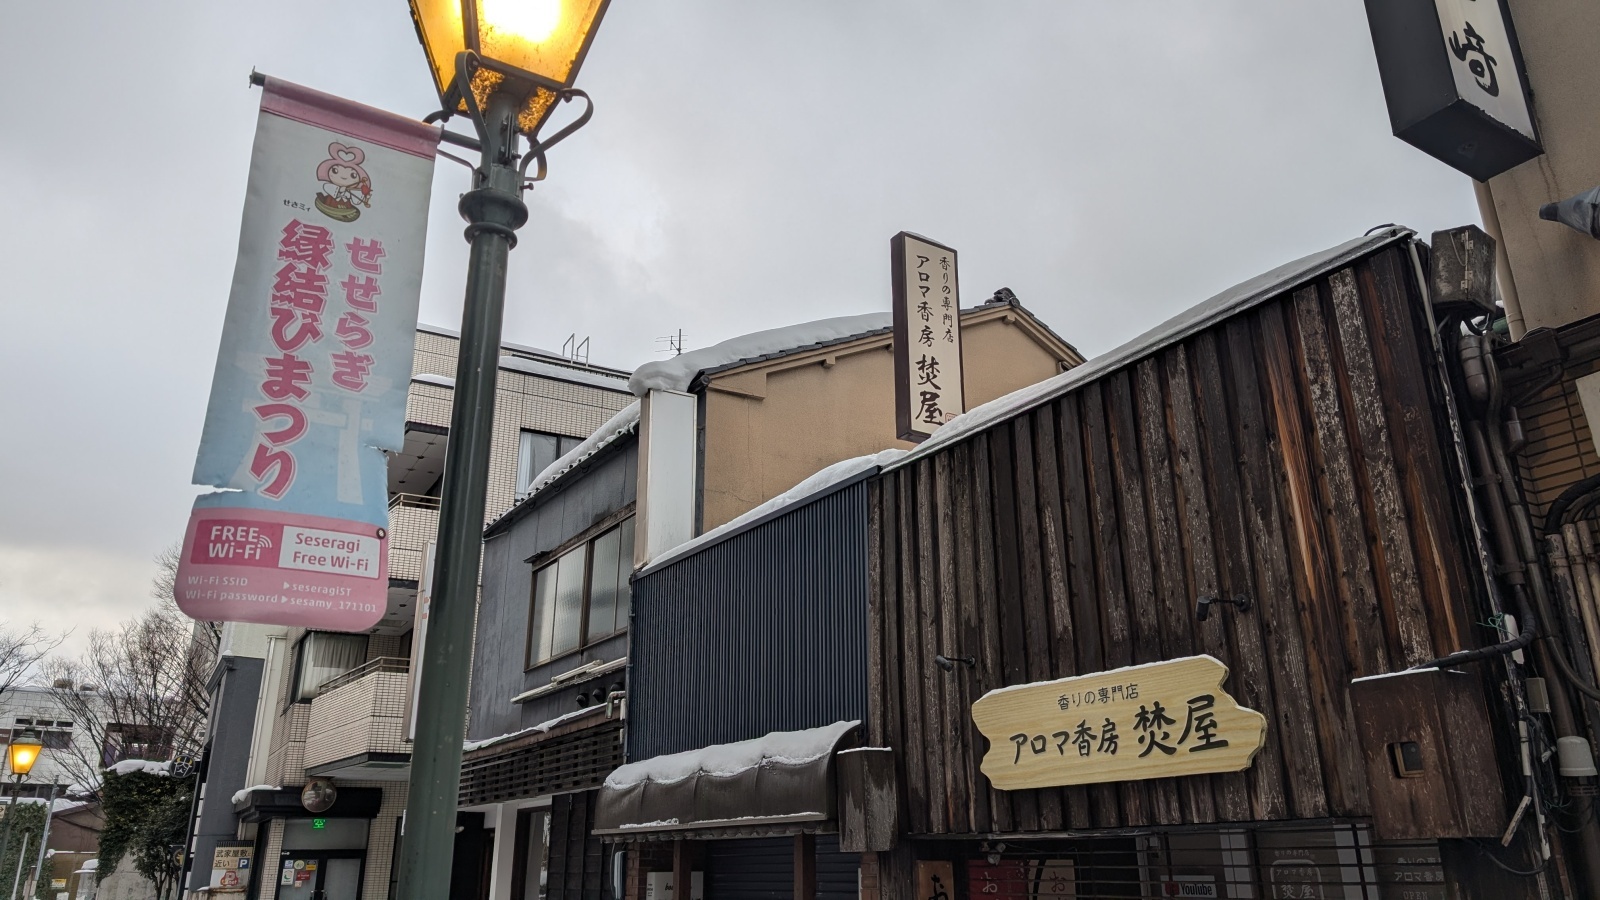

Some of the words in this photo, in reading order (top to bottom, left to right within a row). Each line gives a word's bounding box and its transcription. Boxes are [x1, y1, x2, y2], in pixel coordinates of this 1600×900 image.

[916, 254, 935, 348] アロマ香房
[939, 256, 954, 344] 香りの専門店
[329, 236, 386, 392] せせらぎ
[250, 219, 335, 500] 縁結びまつり
[915, 353, 944, 426] 焚屋
[210, 525, 259, 542] FREE
[295, 532, 360, 553] Seseragi
[208, 542, 261, 560] Wi-Fi
[293, 551, 326, 566] Free
[330, 555, 368, 571] Wi-Fi
[187, 575, 219, 585] Wi-Fi
[222, 576, 248, 586] SSID
[292, 583, 352, 596] seseragiST
[185, 590, 217, 599] Wi-Fi
[220, 590, 278, 603] password
[290, 597, 377, 612] sesamy_171101
[1057, 683, 1139, 711] 香りの専門店
[1009, 717, 1119, 765] アロマ香房
[1133, 694, 1229, 758] 焚屋
[239, 859, 248, 868] P
[1180, 883, 1213, 896] YouTube
